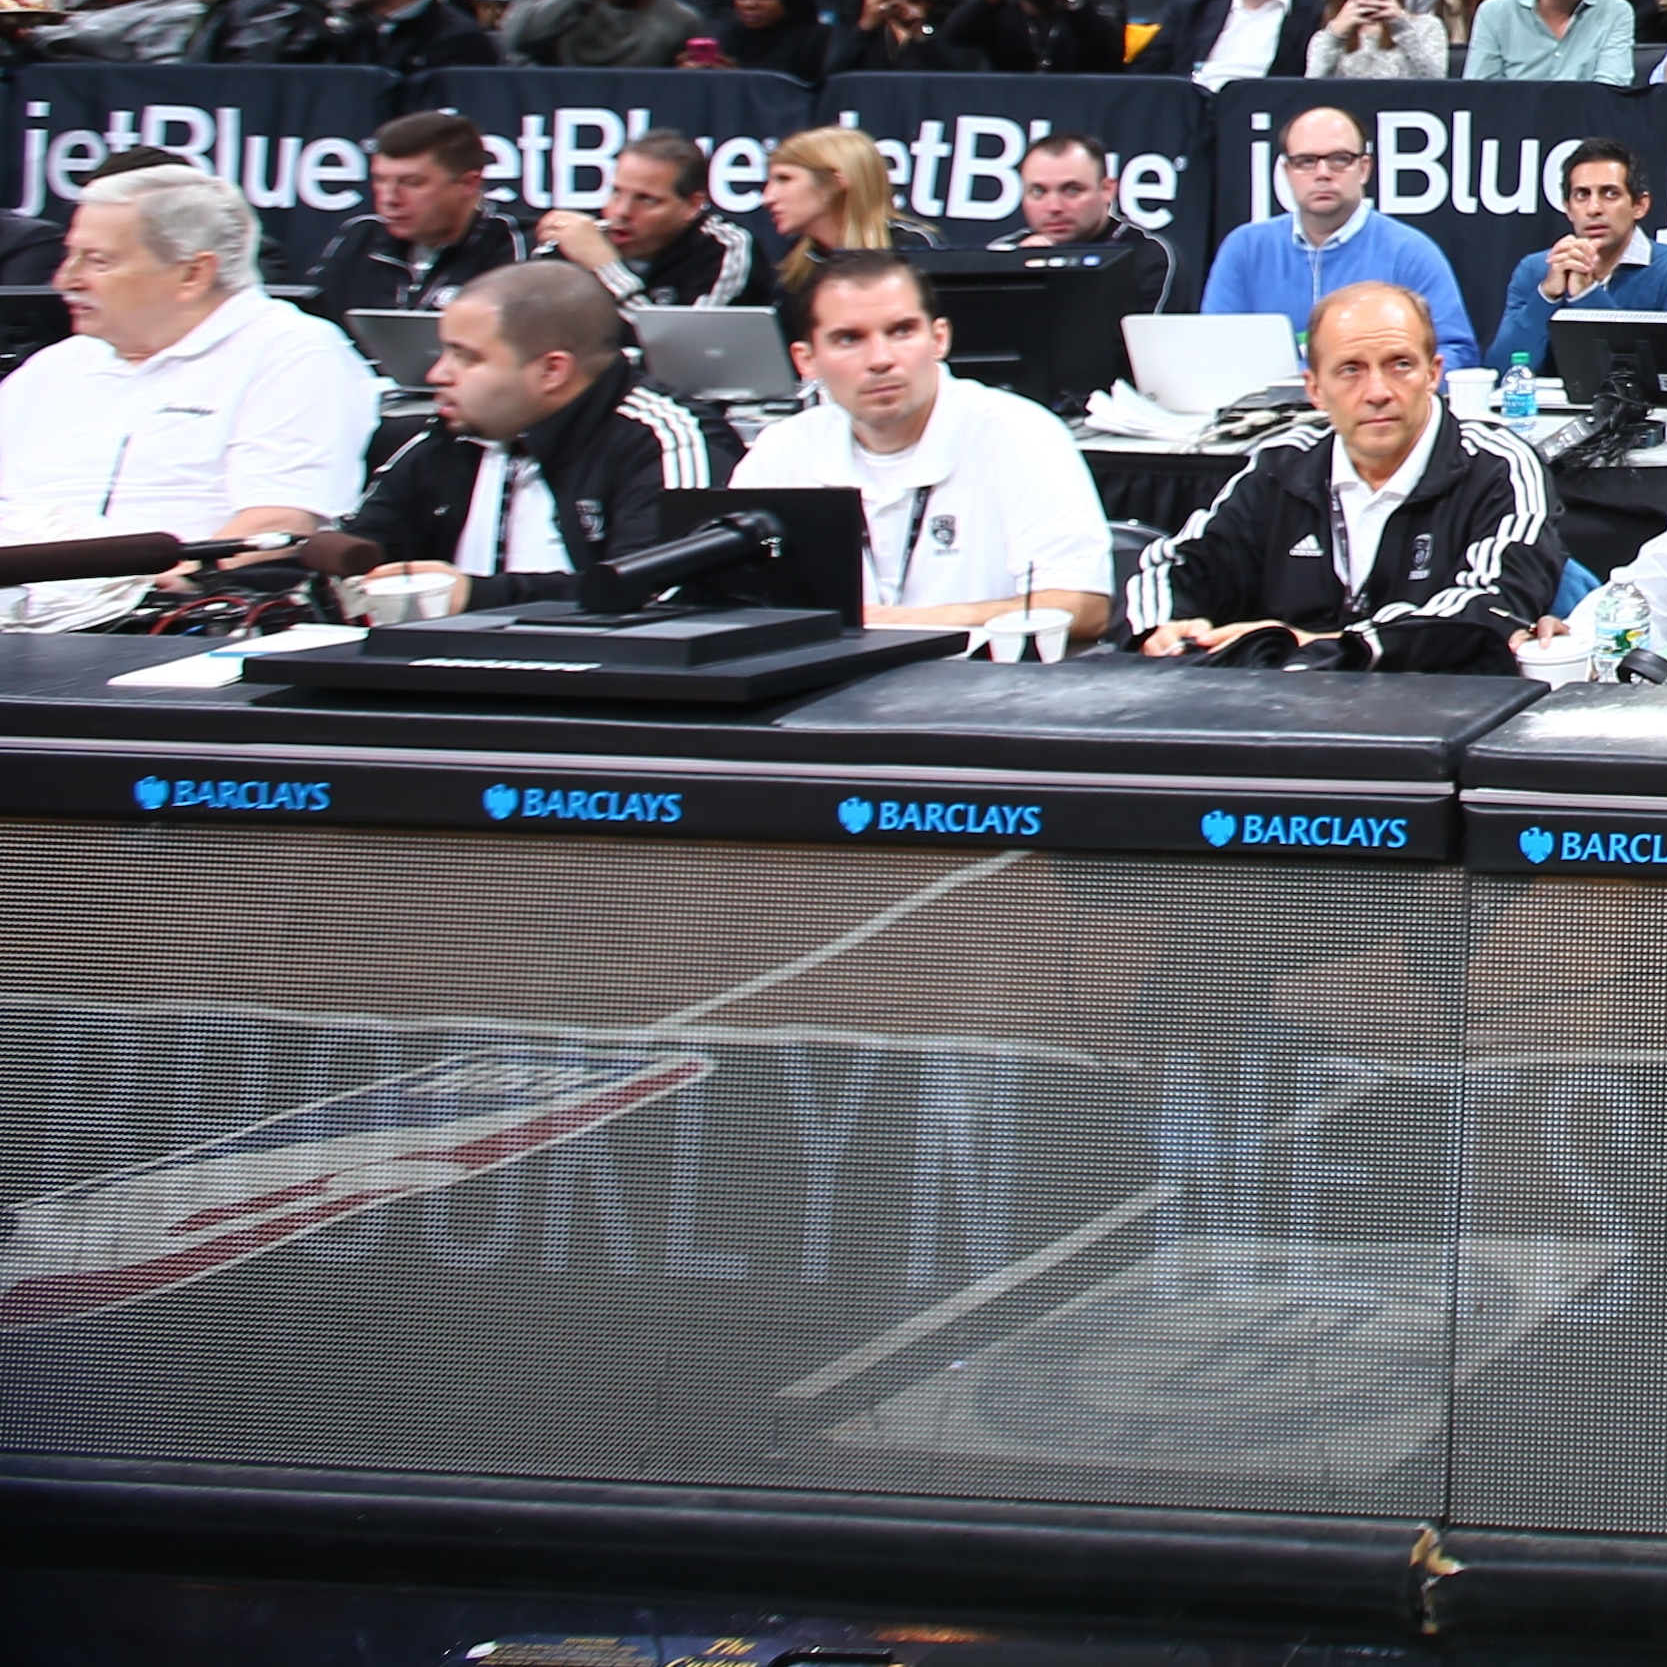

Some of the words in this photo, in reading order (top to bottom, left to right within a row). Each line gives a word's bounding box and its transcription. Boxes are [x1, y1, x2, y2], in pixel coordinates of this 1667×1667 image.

[171, 779, 330, 812] BARCLAYS
[521, 787, 682, 823] BARCLAYS
[876, 800, 1043, 836] BARCLAYS
[1241, 813, 1409, 850] BARCLAYS
